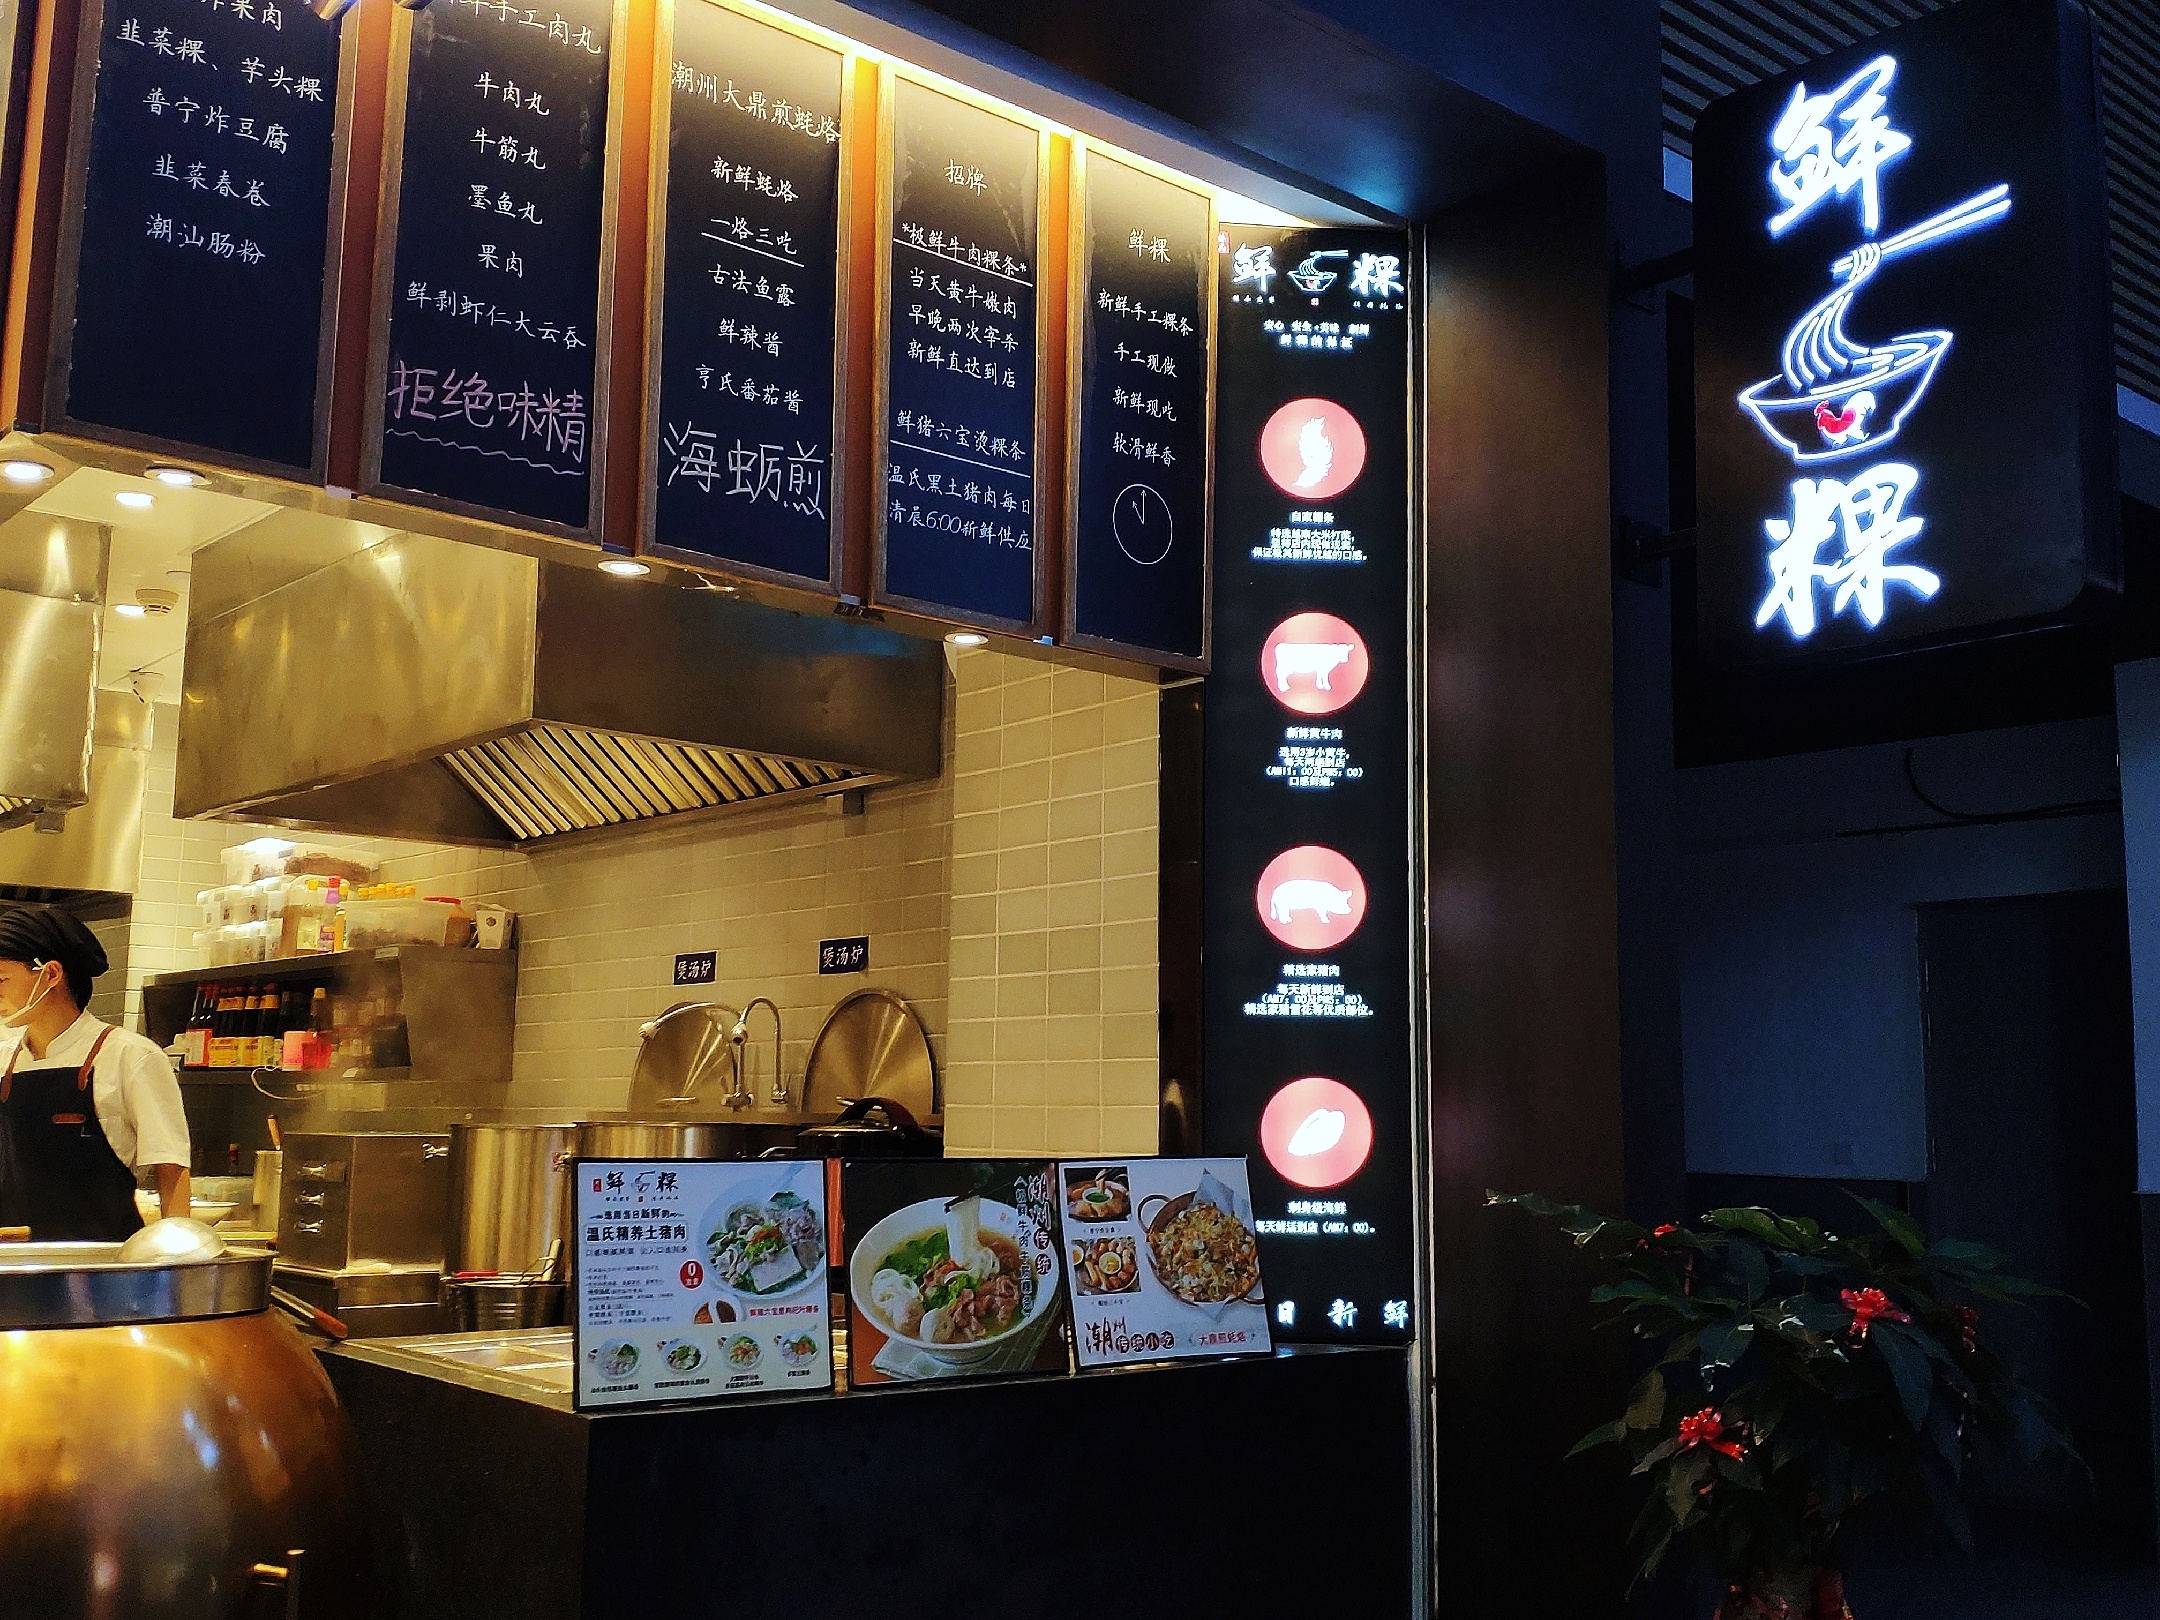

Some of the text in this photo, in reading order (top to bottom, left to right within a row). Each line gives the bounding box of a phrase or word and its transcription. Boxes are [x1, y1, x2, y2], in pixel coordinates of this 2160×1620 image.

[473, 71, 550, 117] 牛肉丸
[142, 86, 290, 155] 普宁炸豆腐
[470, 127, 547, 172] 牛筋丸
[152, 154, 271, 208] 韭菜春卷
[710, 155, 799, 204] 新鲜蚝烙
[943, 158, 988, 197] 招牌
[468, 184, 544, 226] 墨鱼丸
[145, 214, 267, 265] 潮汕肠粉
[710, 215, 798, 255] 一烙三吃
[1128, 228, 1171, 263] 鲜粿
[477, 243, 524, 279] 果肉
[707, 263, 796, 308] 古法鱼露
[909, 266, 1017, 320] 当天黄牛嫩肉
[406, 281, 588, 350] 鲜剥虾仁大云吞
[908, 303, 1019, 353] 早晚两次宰杀
[1097, 288, 1194, 336] 新鲜手工粿条
[717, 317, 783, 358] 鲜辣酱
[1113, 342, 1177, 378] 手工现做
[907, 337, 1016, 389] 新鲜直达到店
[387, 360, 588, 464] 拒绝味精
[695, 364, 804, 415] 亨氏番茄酱
[1112, 385, 1177, 421] 新鲜现吃
[896, 409, 1026, 461] 鲜猪六宝烫粿条
[1112, 431, 1176, 468] 软滑鲜香
[663, 420, 826, 521] 海蛎煎
[888, 462, 1031, 515] 温氏黑土猪肉每日
